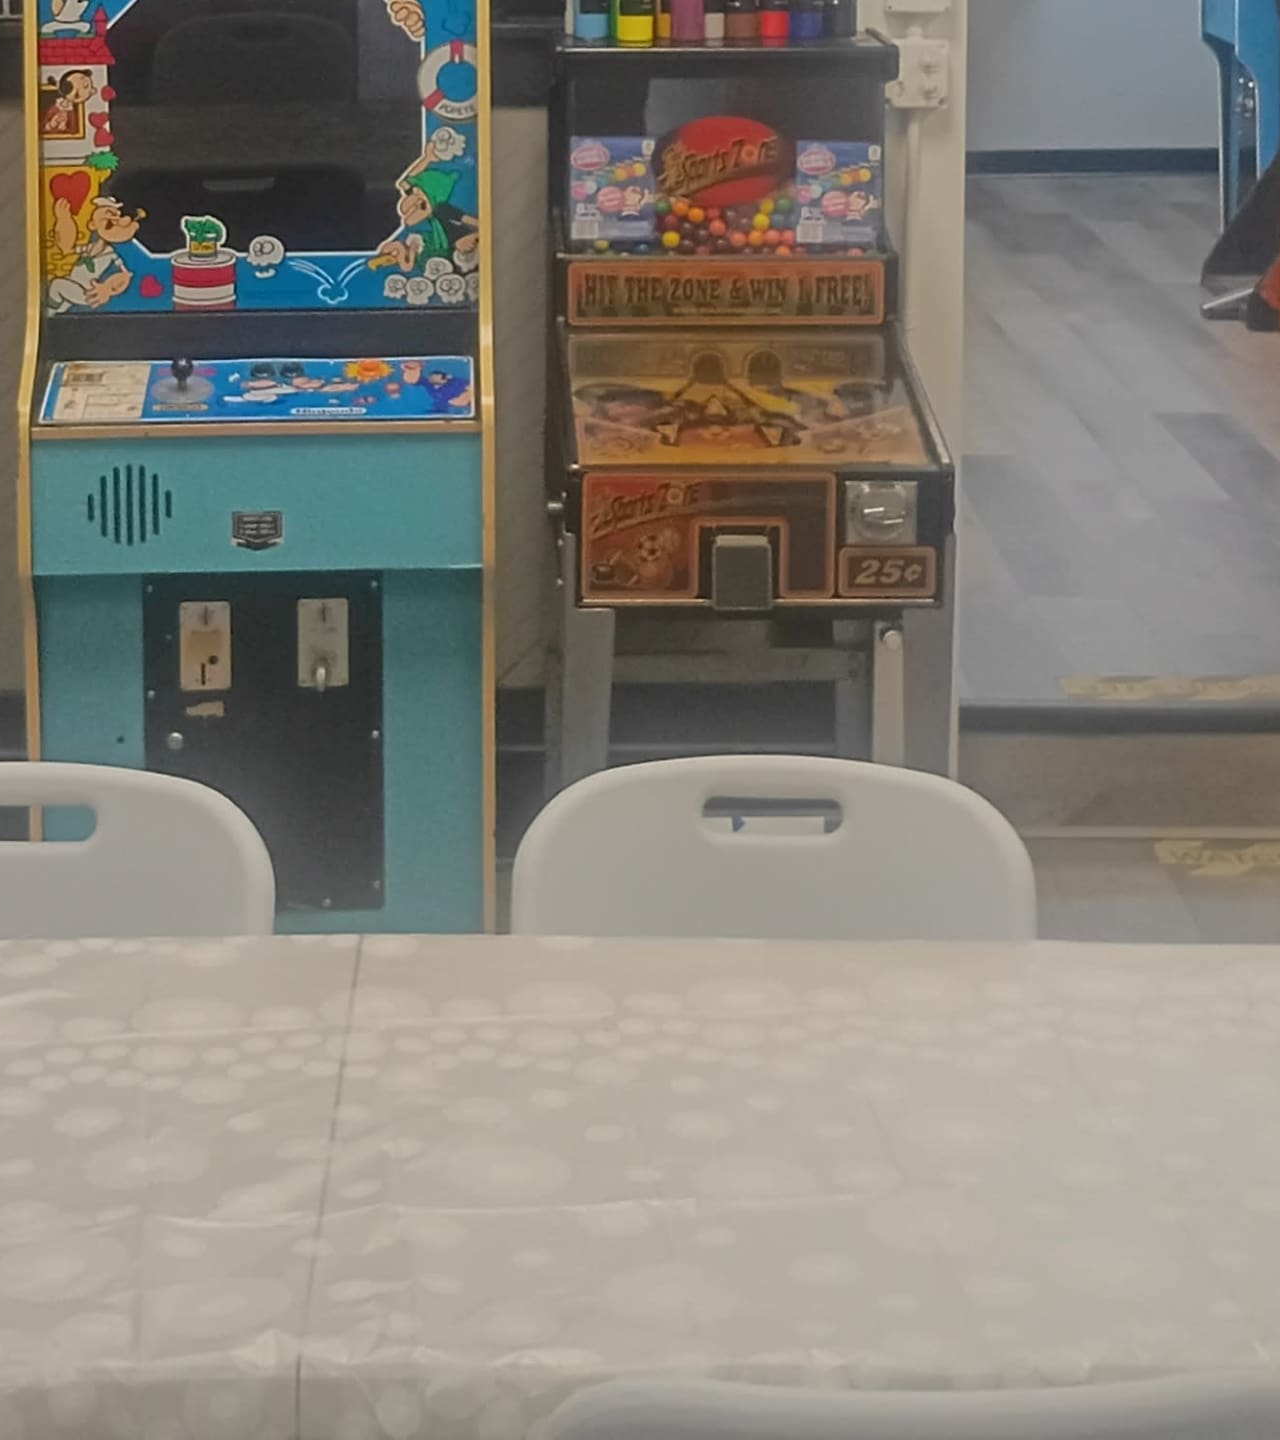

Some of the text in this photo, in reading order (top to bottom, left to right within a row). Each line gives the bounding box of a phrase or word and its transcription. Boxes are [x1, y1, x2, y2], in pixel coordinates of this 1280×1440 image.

[585, 273, 618, 304] HIT
[624, 274, 662, 304] THE
[669, 276, 721, 303] ZONE
[730, 277, 744, 302] &
[749, 275, 789, 303] WIN
[814, 274, 870, 307] FREE!
[854, 559, 923, 586] 25¢
